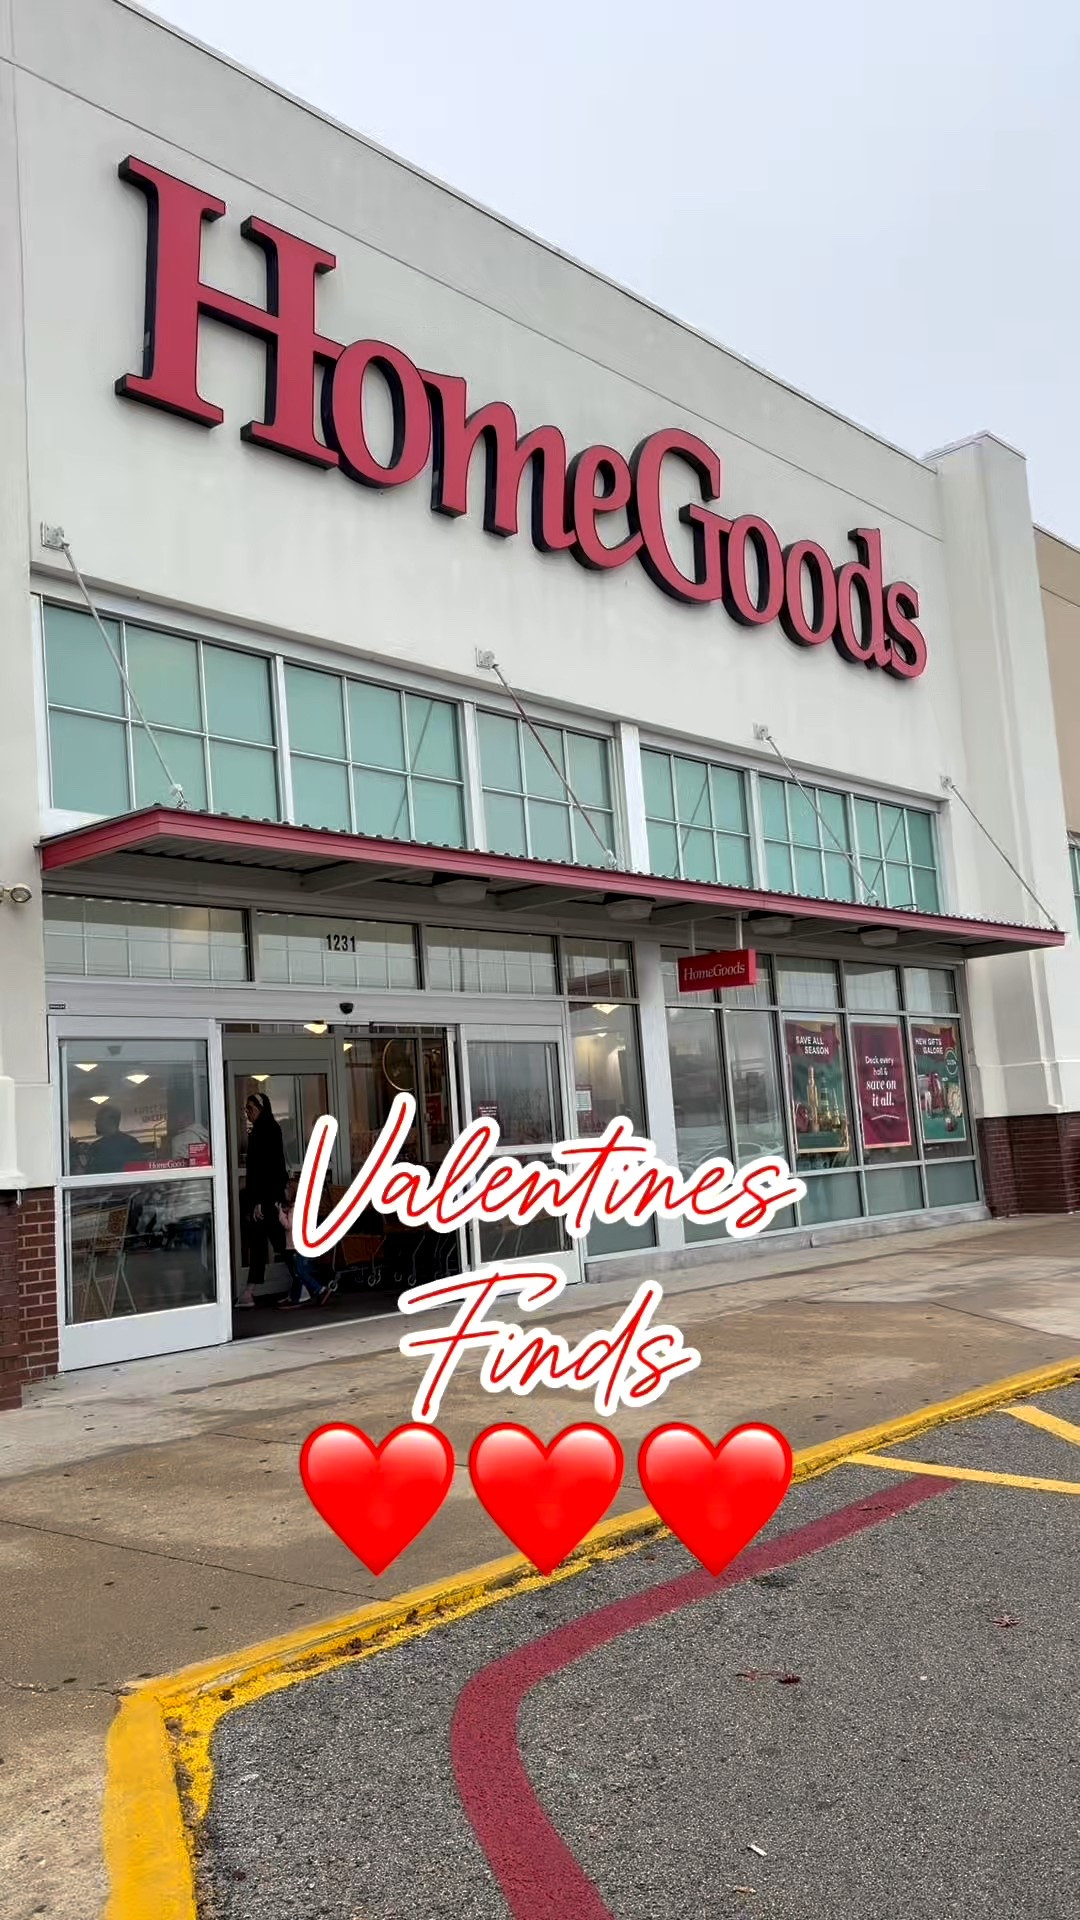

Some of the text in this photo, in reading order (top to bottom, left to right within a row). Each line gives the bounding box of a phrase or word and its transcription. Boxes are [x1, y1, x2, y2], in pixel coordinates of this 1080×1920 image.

[115, 154, 927, 680] HomeGoods
[326, 934, 356, 953] 1231
[683, 961, 746, 982] HomeGoods
[795, 1035, 824, 1045] SAVE ALL
[915, 1037, 942, 1046] NEW GIFTS
[804, 1046, 830, 1055] SEASON
[922, 1046, 944, 1055] GALORE
[865, 1055, 895, 1067] Deck every
[872, 1067, 884, 1076] hall
[866, 1079, 897, 1090] save on
[872, 1091, 895, 1107] it all.
